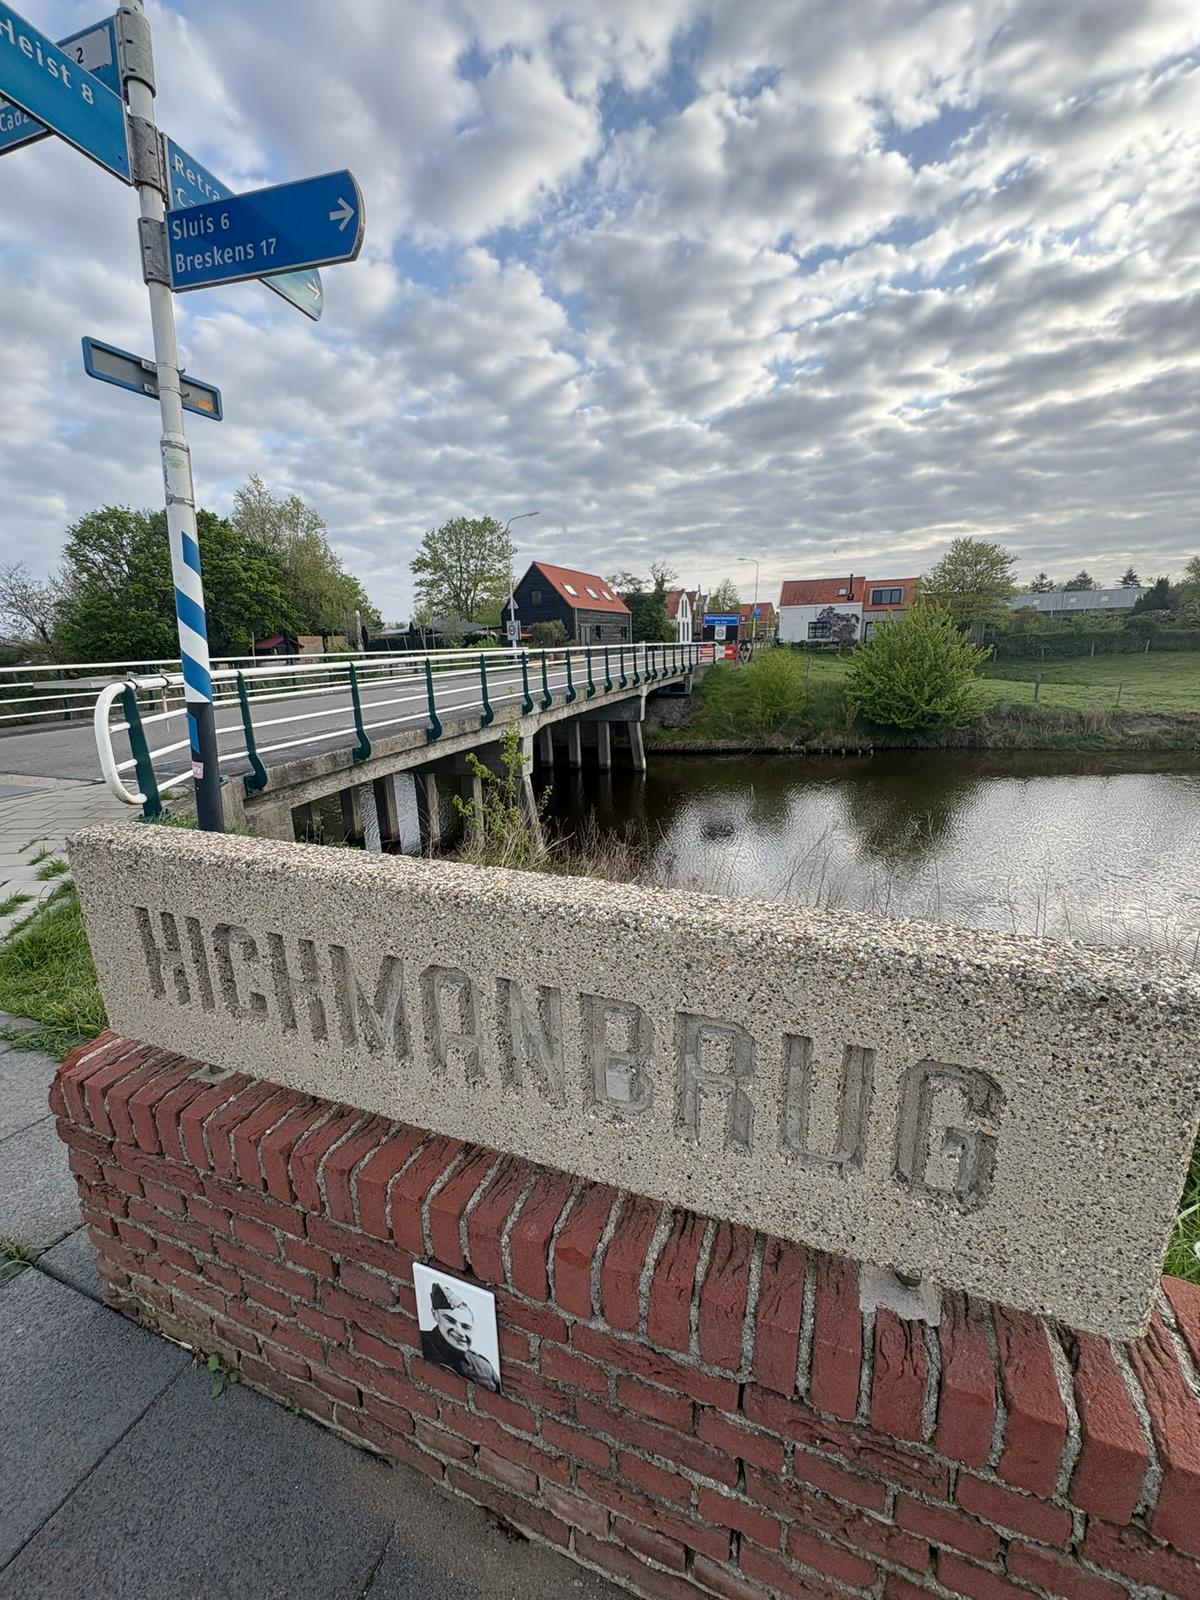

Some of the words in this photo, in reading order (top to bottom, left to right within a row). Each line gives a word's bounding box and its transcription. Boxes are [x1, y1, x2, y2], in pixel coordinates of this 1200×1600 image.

[0, 19, 72, 89] Heist
[81, 83, 94, 105] 8
[172, 213, 214, 240] Sluis
[220, 212, 230, 230] 6
[175, 245, 255, 273] Breskens
[260, 238, 277, 256] 17
